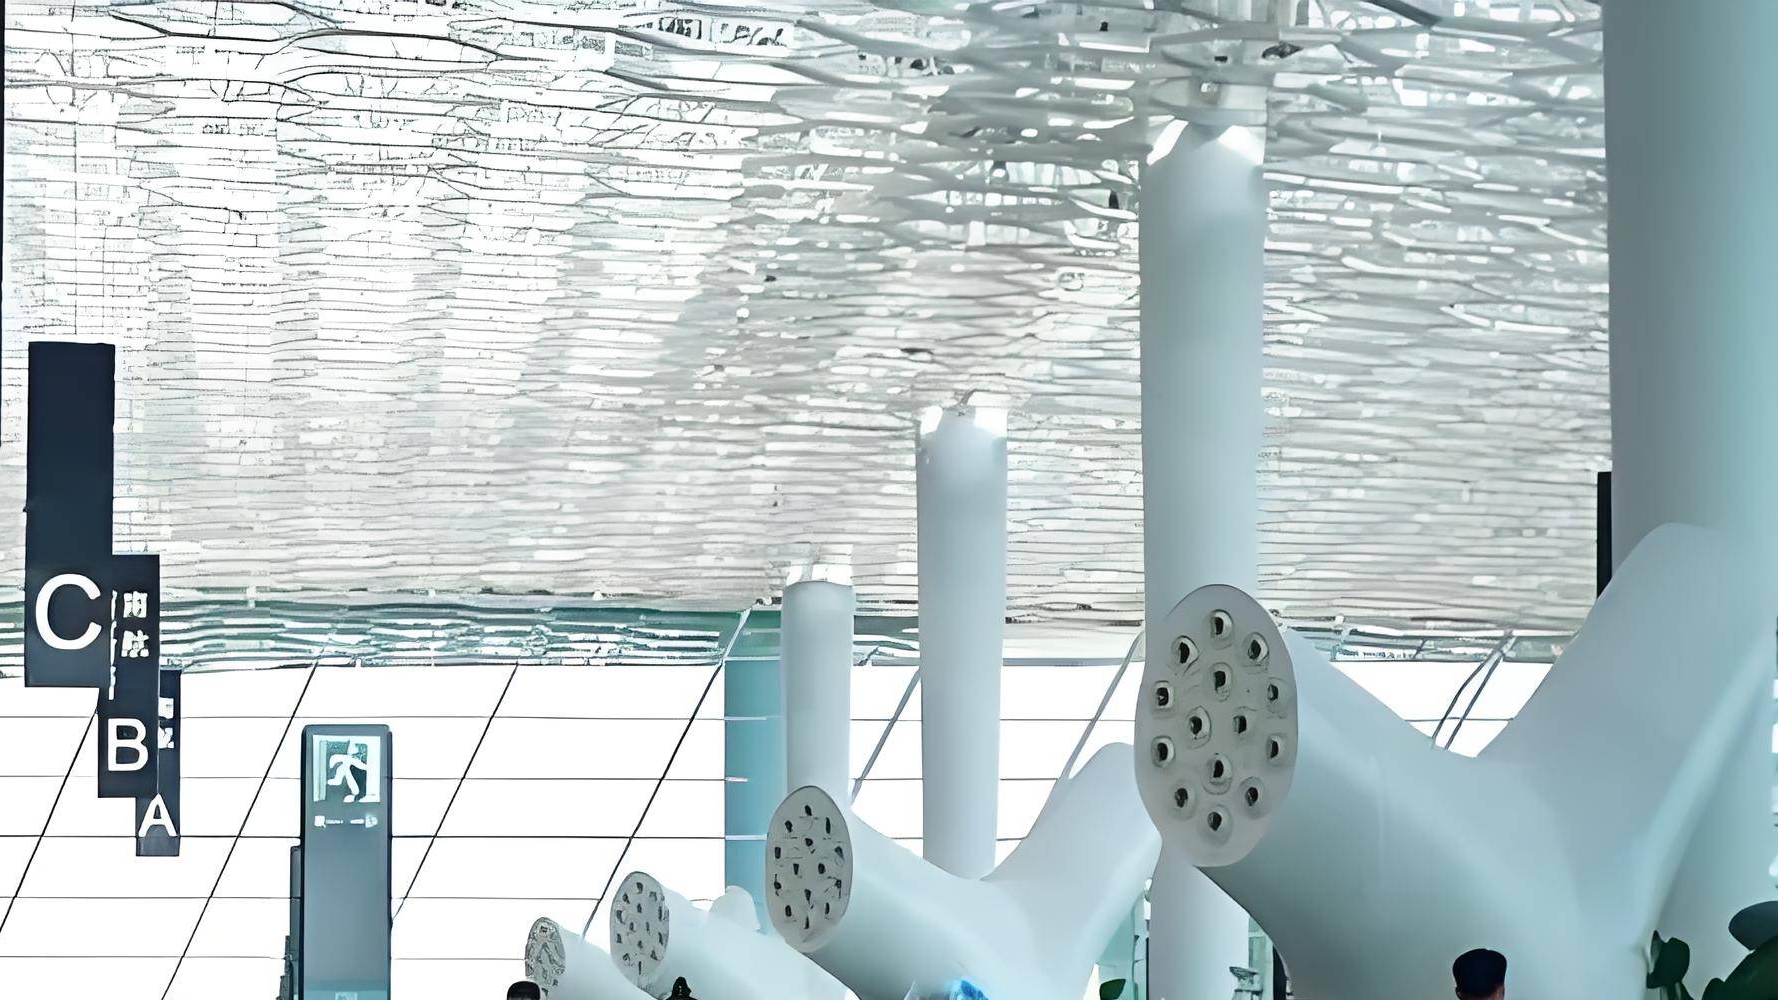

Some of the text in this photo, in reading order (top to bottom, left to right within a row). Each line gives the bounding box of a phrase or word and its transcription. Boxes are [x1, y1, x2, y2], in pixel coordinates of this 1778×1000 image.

[35, 573, 103, 651] C
[107, 717, 149, 772] B
[137, 793, 177, 837] A
